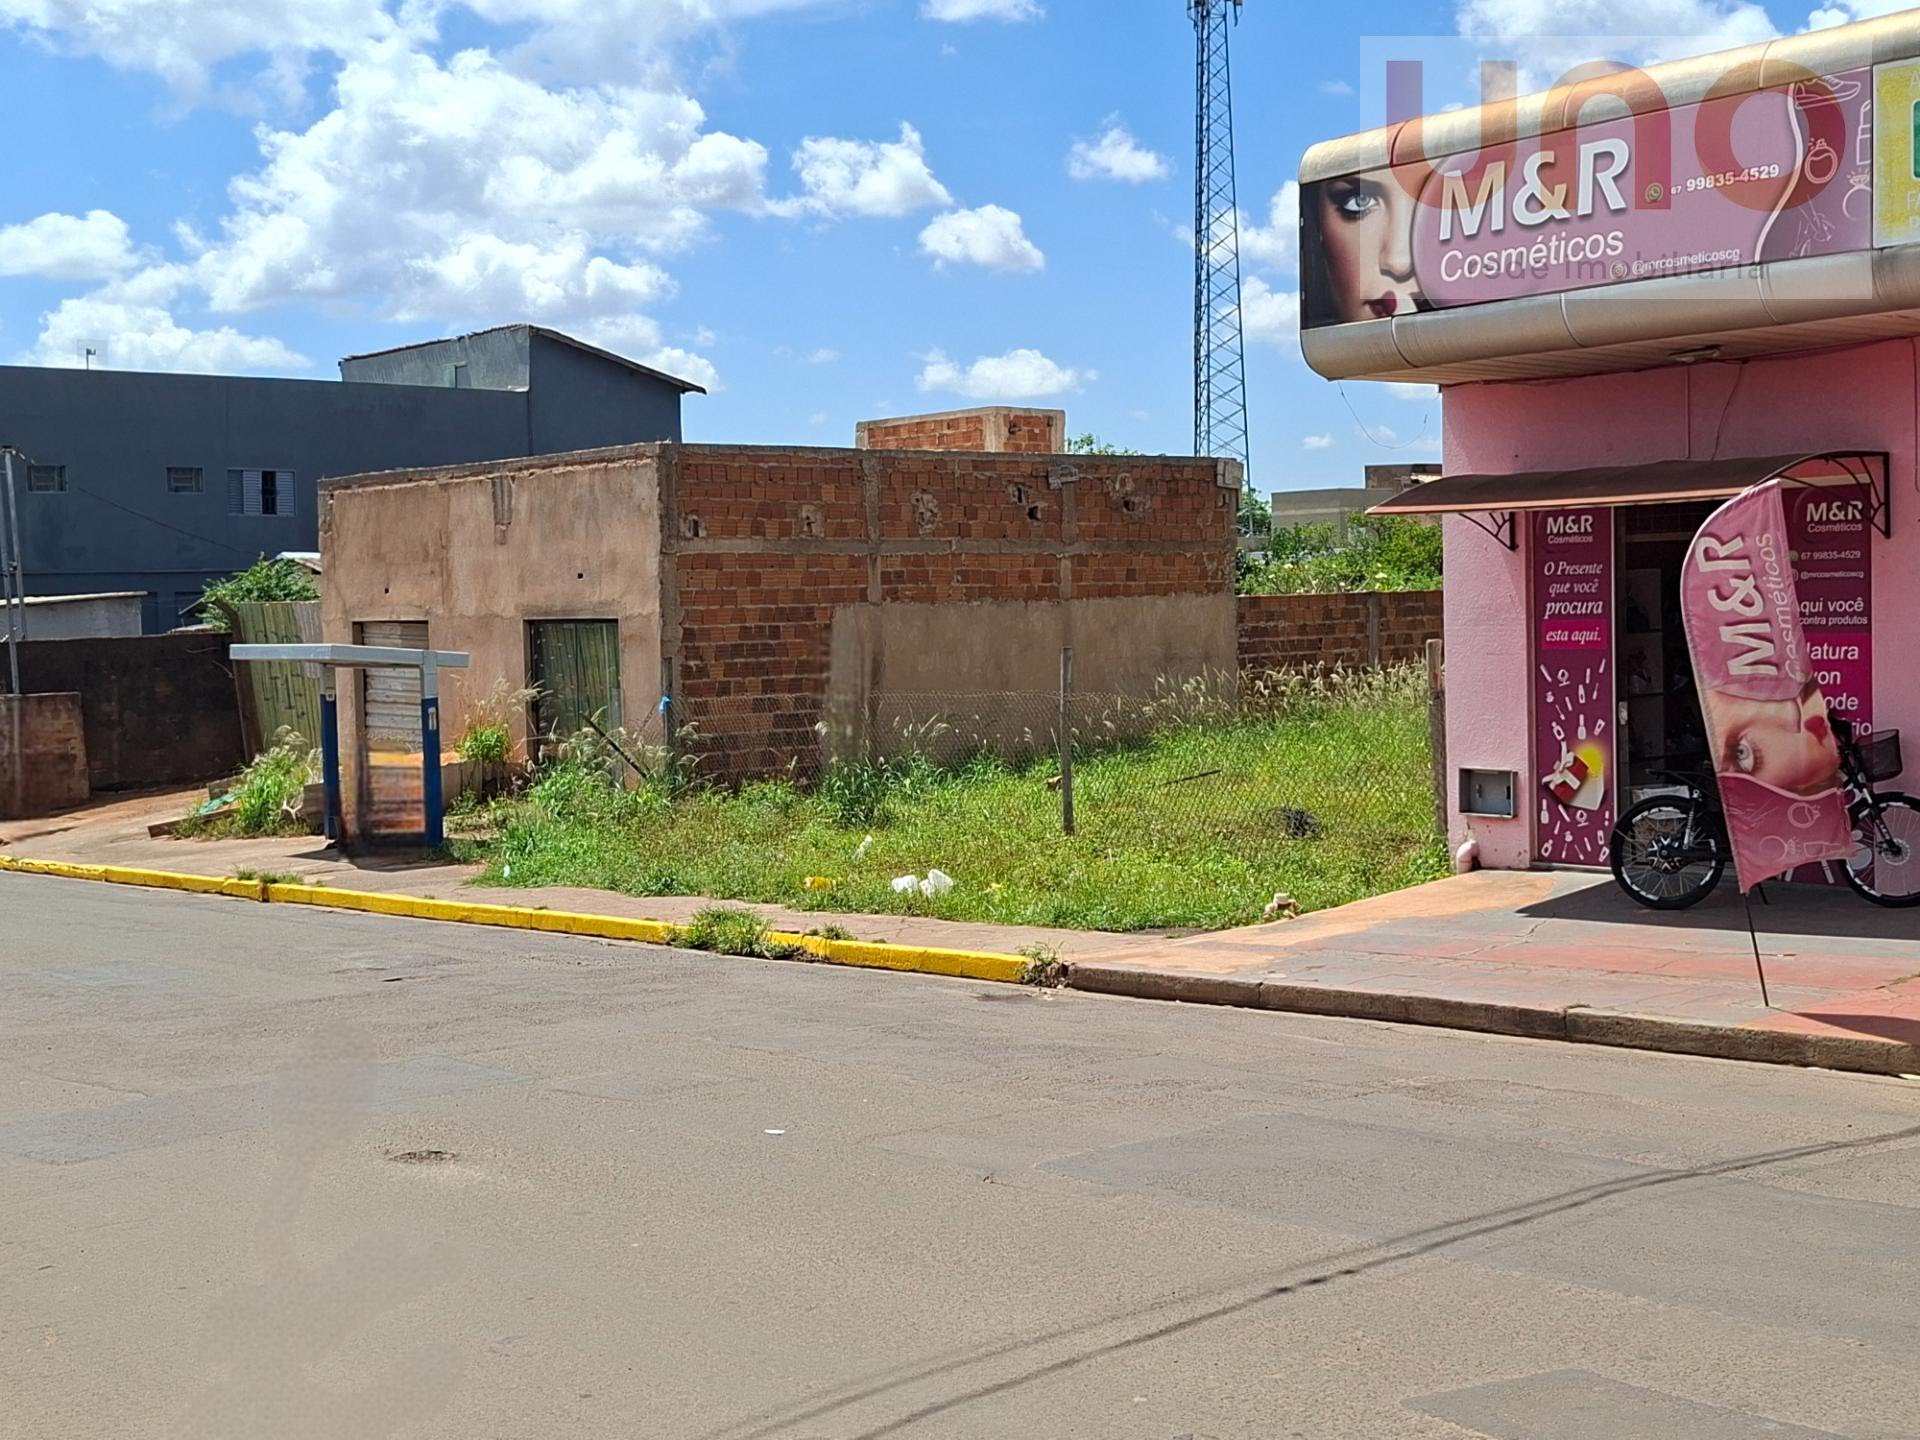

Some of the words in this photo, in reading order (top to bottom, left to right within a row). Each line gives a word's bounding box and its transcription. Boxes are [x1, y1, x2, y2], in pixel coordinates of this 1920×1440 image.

[1671, 186, 1682, 195] 67
[1686, 164, 1780, 191] 99835-4529
[1438, 138, 1630, 241] M&R
[1440, 229, 1624, 283] Cosméticos
[1632, 248, 1740, 275] @mrcosmeticoscg
[1806, 501, 1863, 522] M&R
[1546, 515, 1593, 534] M&R
[1807, 522, 1863, 533] Cosméticos
[1547, 535, 1593, 544] Cosméticos
[1801, 552, 1811, 560] 67
[1813, 550, 1861, 560] 99835-4529
[1544, 561, 1555, 575] O
[1557, 561, 1603, 575] Presente
[1549, 582, 1571, 597] que
[1573, 579, 1599, 593] você
[1544, 601, 1603, 619] procura
[1695, 536, 1778, 676] M&R
[1756, 533, 1807, 682] Cosméticos
[1800, 597, 1824, 615] qui
[1827, 597, 1864, 612] você
[1799, 615, 1826, 625] contra
[1828, 614, 1868, 627] produtos
[1546, 629, 1568, 641] esta
[1571, 627, 1602, 645] aqui.
[1806, 642, 1859, 660] atura
